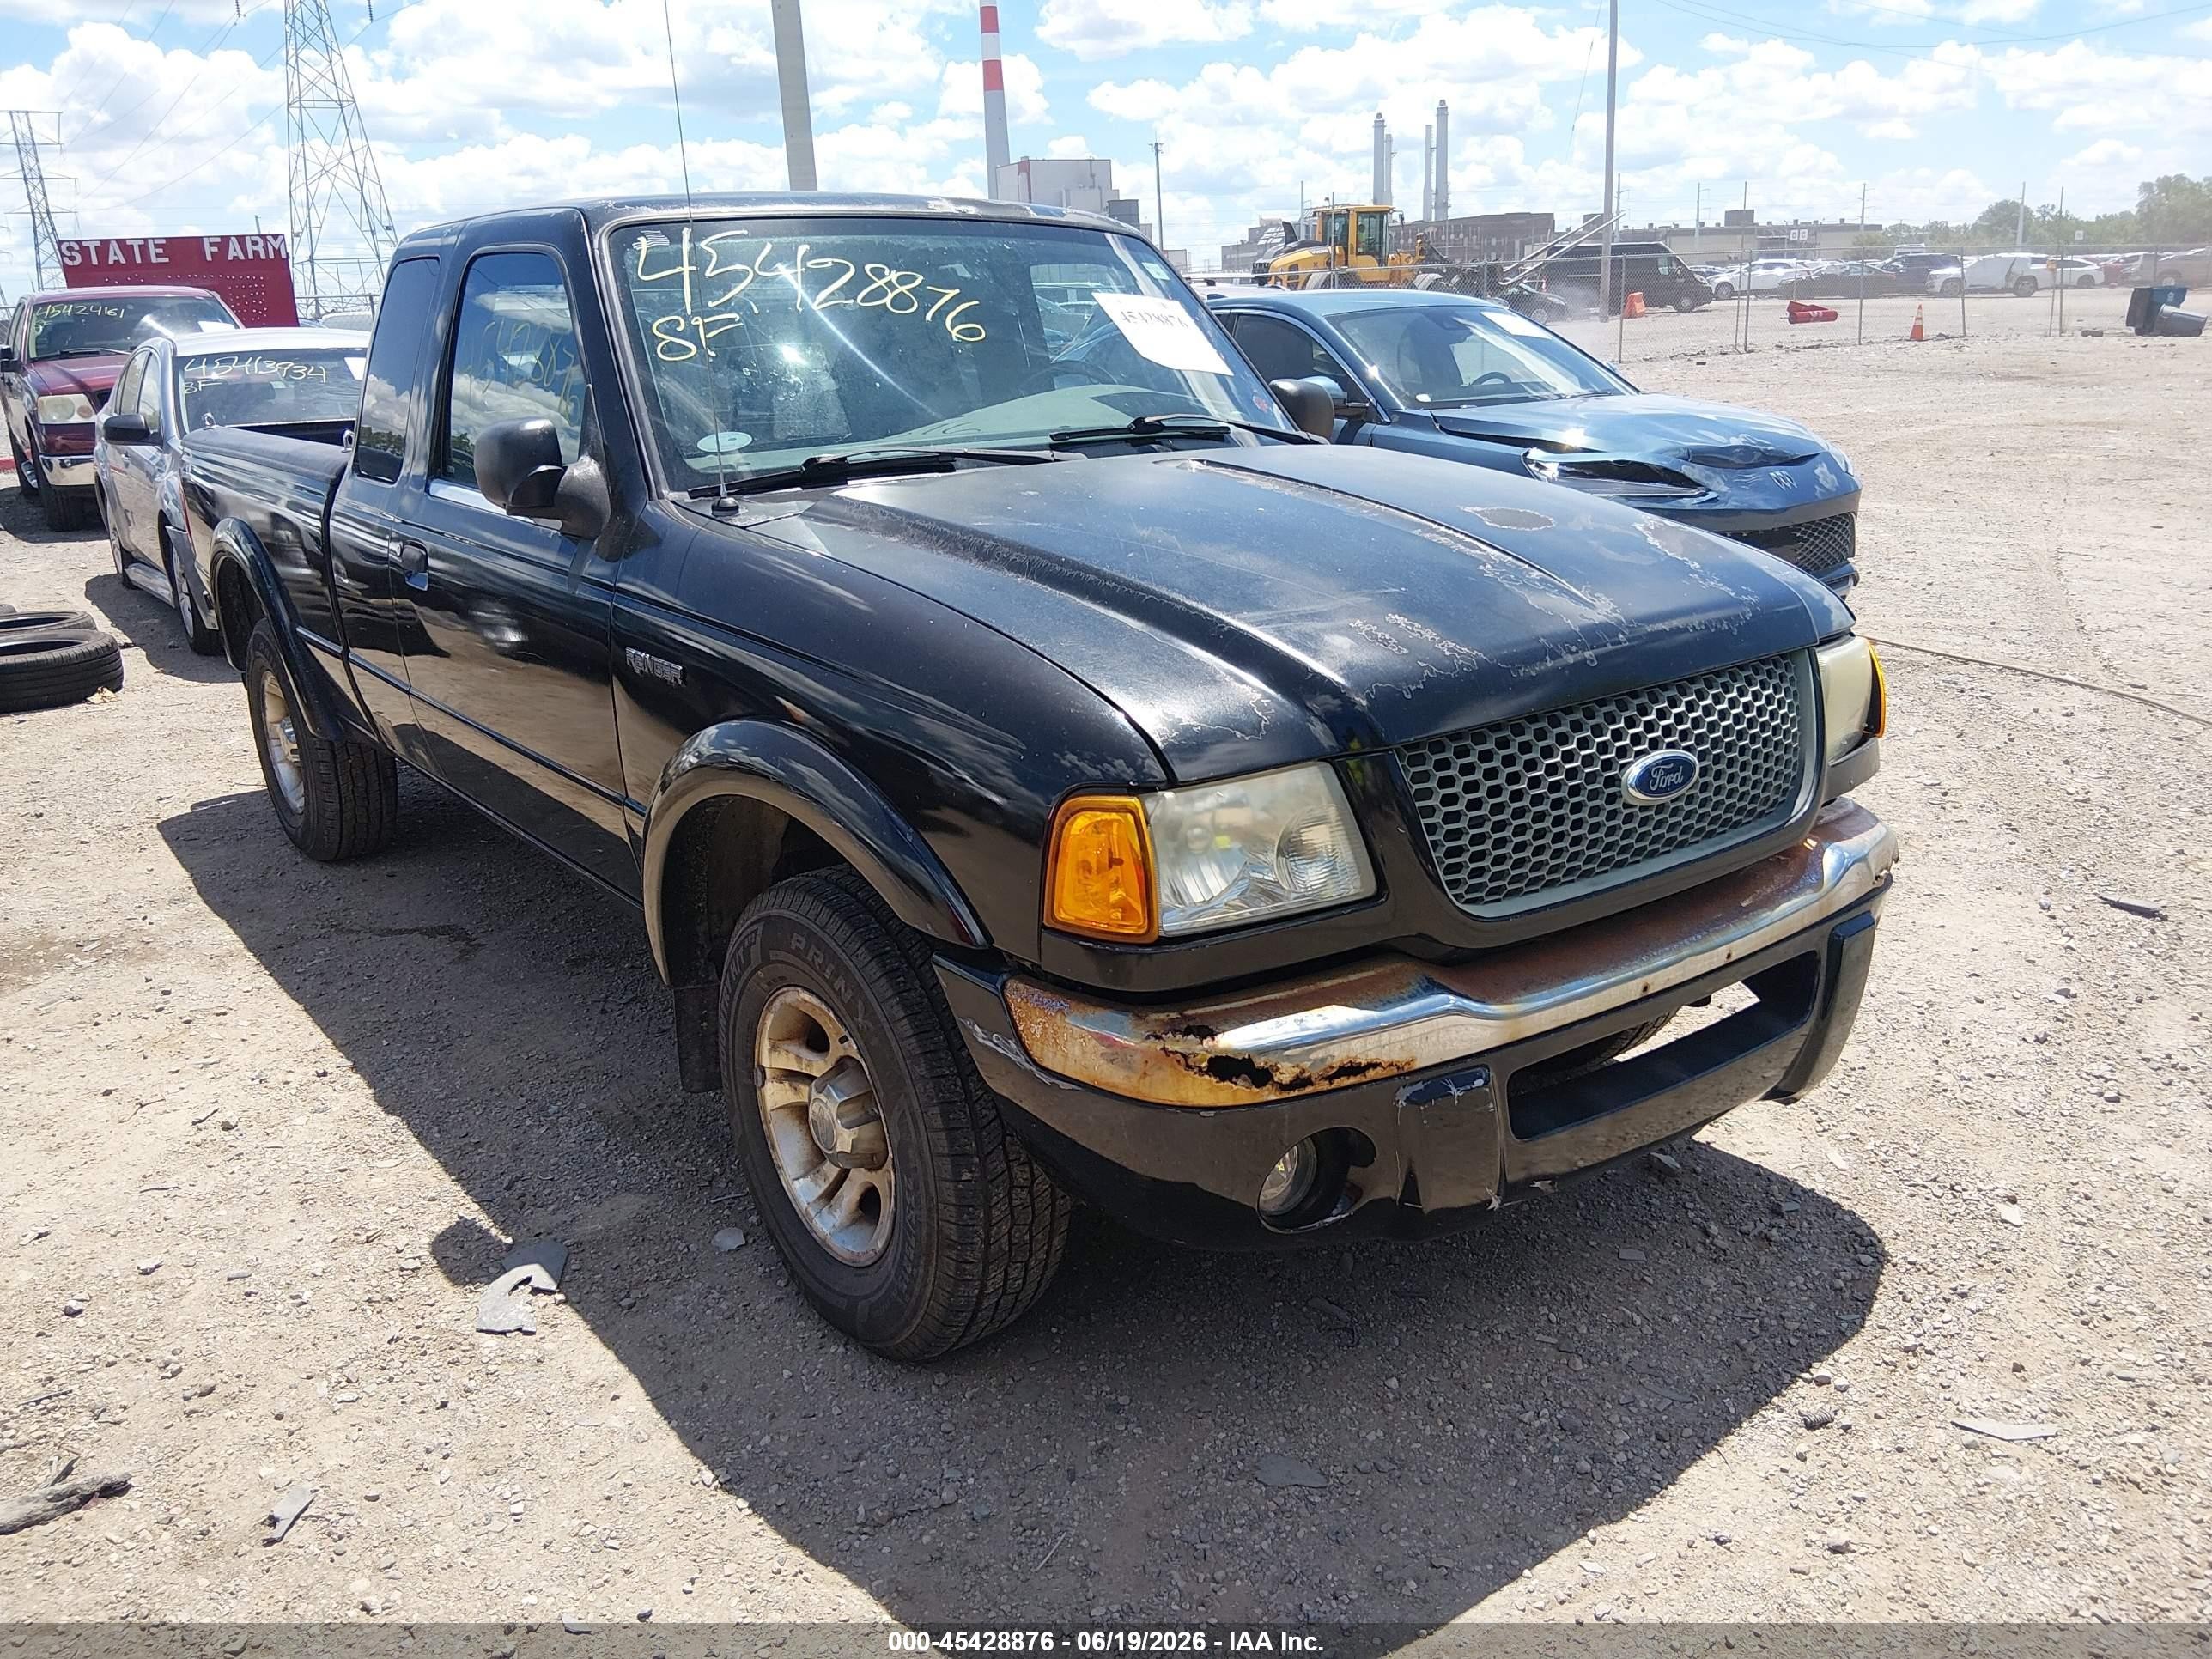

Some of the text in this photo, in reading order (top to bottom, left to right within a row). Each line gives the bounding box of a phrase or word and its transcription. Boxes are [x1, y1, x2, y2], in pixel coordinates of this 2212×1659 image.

[60, 235, 288, 267] STATE FARM
[636, 227, 988, 343] 45428876
[36, 303, 125, 319] 45424161
[184, 356, 326, 384] 45413934
[625, 647, 684, 686] RANGER
[1649, 763, 1684, 791] Ford
[790, 932, 872, 1031] PRINX
